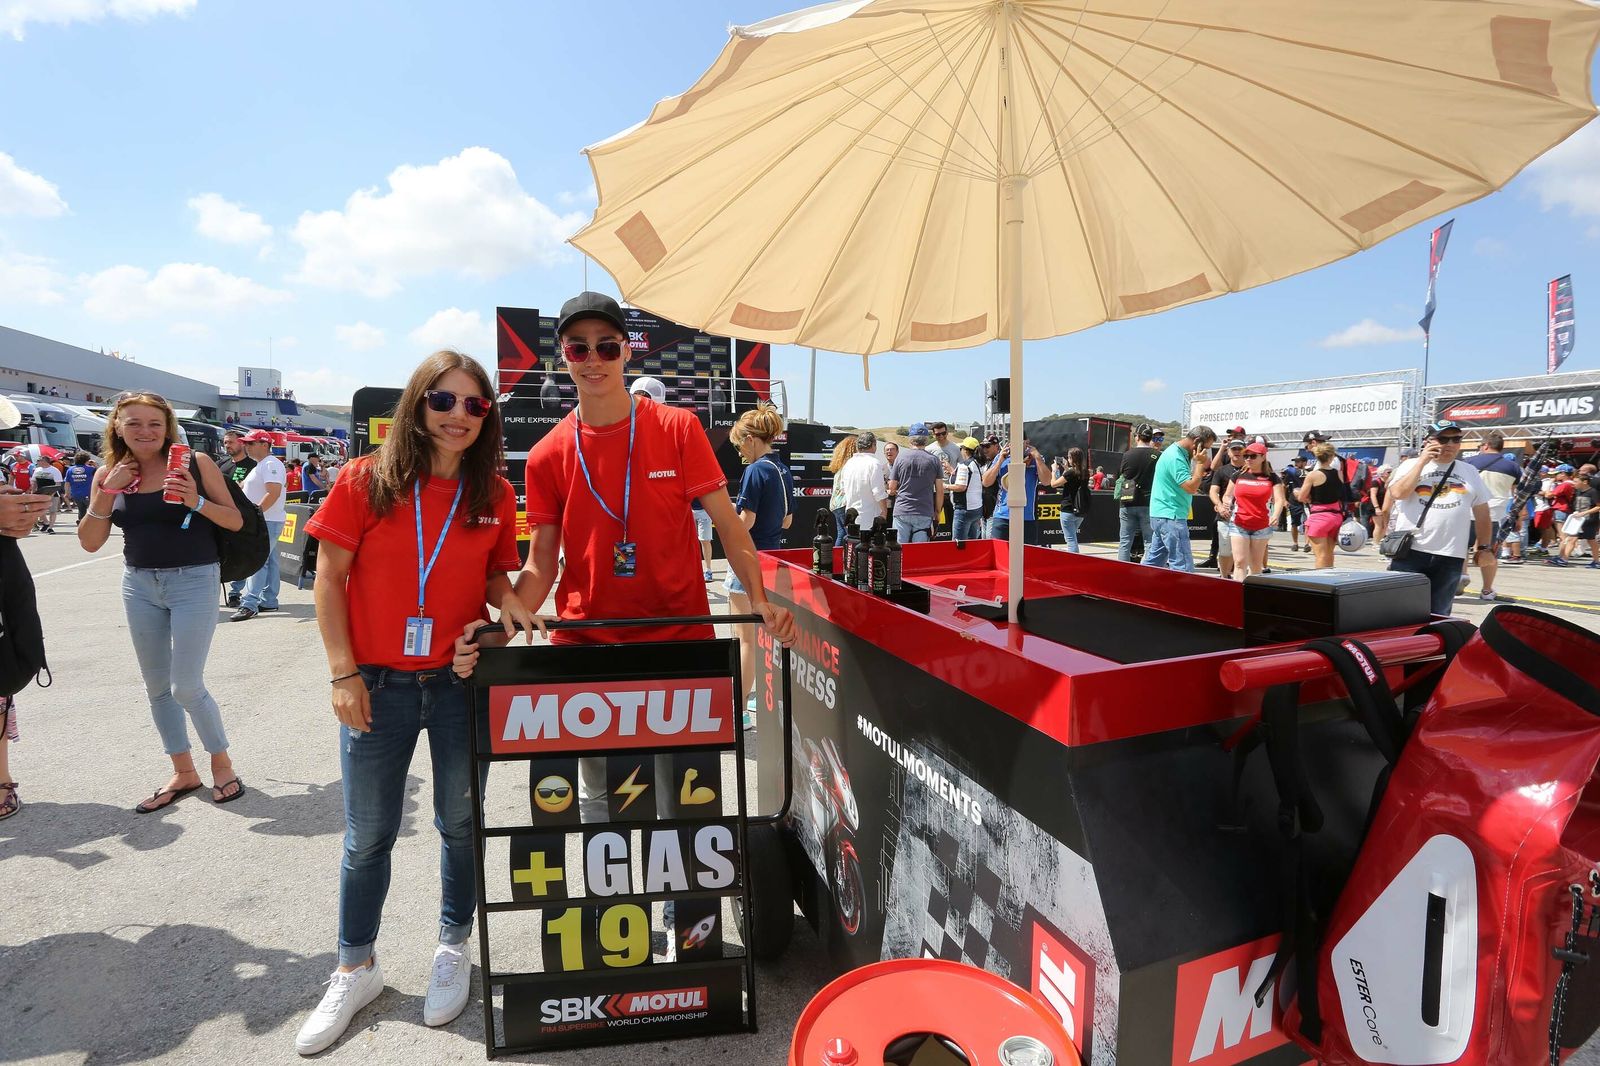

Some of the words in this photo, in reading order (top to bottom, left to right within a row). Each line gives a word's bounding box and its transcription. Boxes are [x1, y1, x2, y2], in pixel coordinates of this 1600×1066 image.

[504, 416, 526, 424] PURE
[1200, 412, 1233, 423] PROSECCO
[1235, 410, 1249, 420] DOC
[1260, 407, 1298, 419] PROSECCO
[1300, 405, 1317, 416] DOC
[1329, 402, 1375, 414] PROSECCO
[1378, 400, 1398, 411] DOC
[1517, 396, 1594, 418] TEAMS
[648, 470, 676, 479] MOTUL
[765, 632, 774, 711] CARE
[772, 638, 837, 709] EPRESS
[1346, 643, 1375, 682] MOTUL
[501, 688, 723, 741] MOTUL
[857, 714, 982, 826] #MOTULMOMENTS
[546, 904, 650, 972] 19
[540, 994, 608, 1024] SBK
[629, 990, 704, 1013] MOTUL
[541, 1024, 556, 1033] FIM
[558, 1021, 607, 1032] SUPERBIKE
[607, 1019, 640, 1028] WORLD
[641, 1011, 708, 1024] CHAMPIONSHIP
